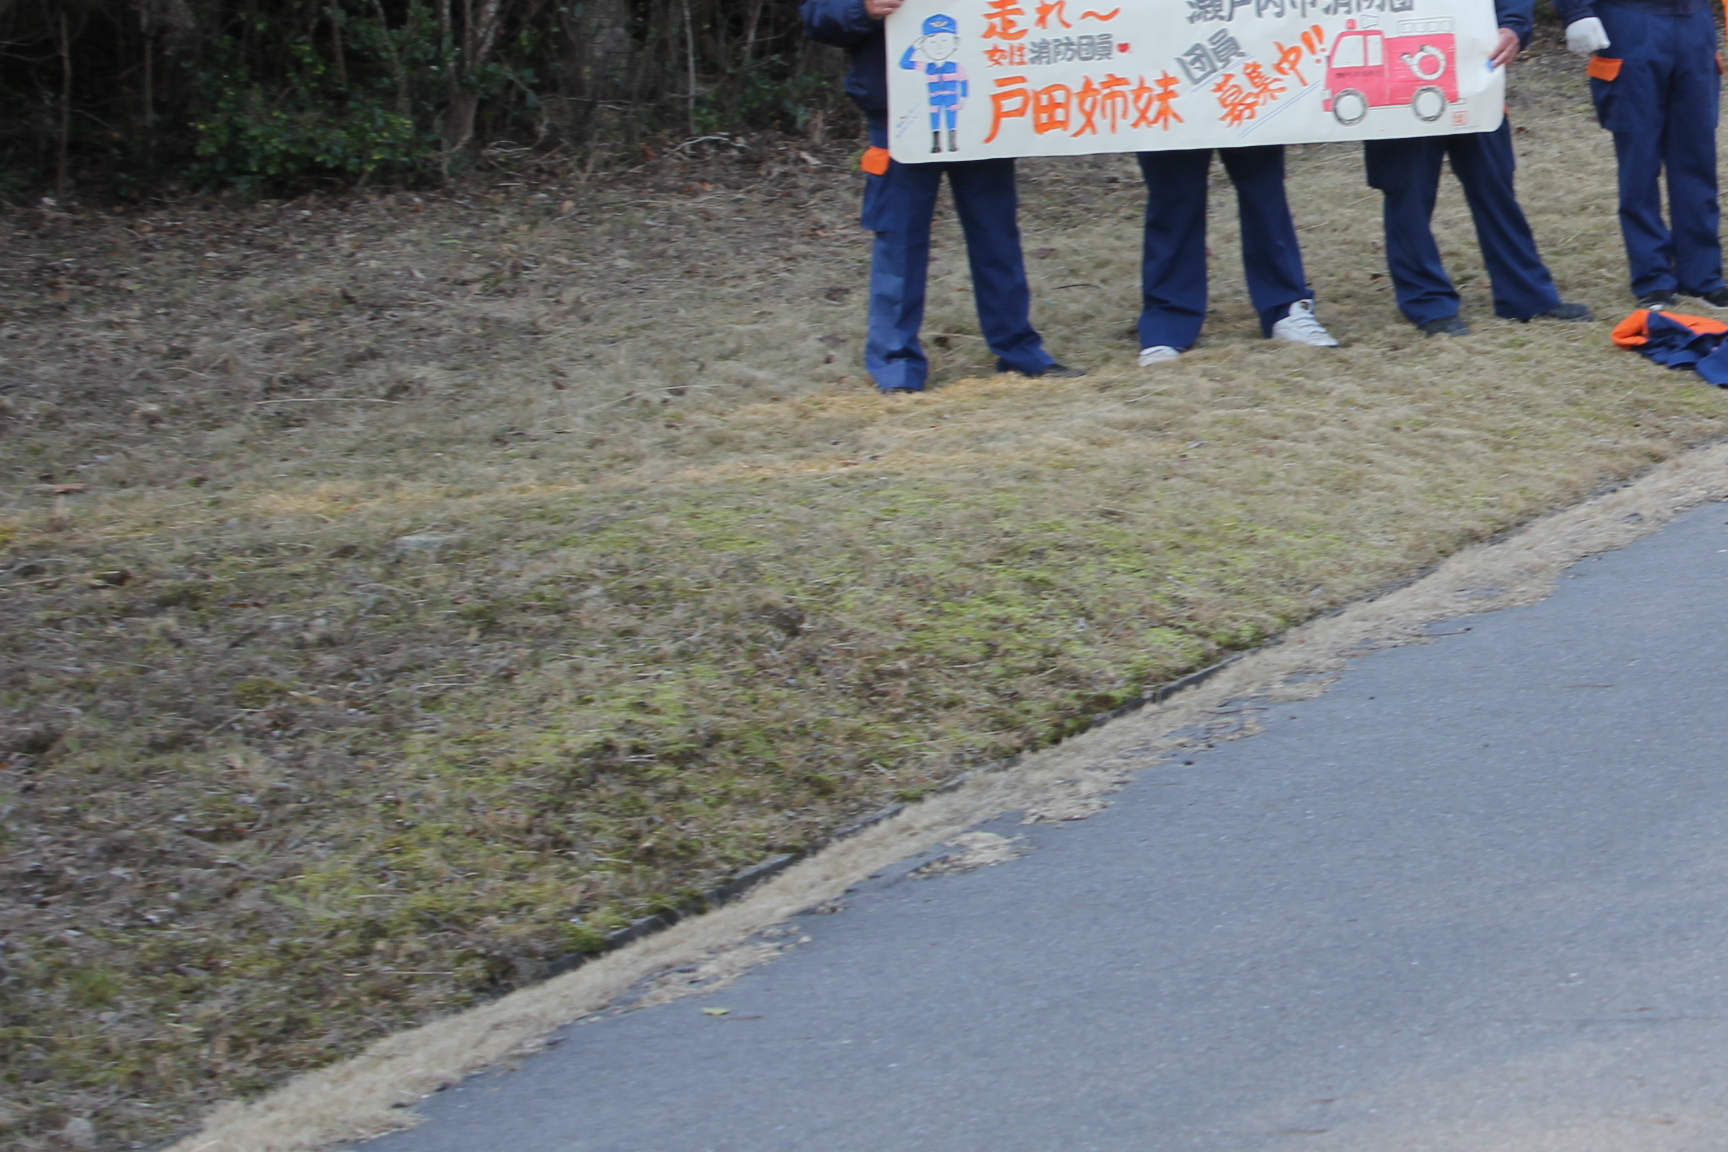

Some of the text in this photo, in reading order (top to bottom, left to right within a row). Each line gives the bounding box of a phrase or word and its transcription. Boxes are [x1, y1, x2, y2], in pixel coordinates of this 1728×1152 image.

[1175, 28, 1246, 85] 団員
[983, 70, 1184, 144] 戸田姉妹
